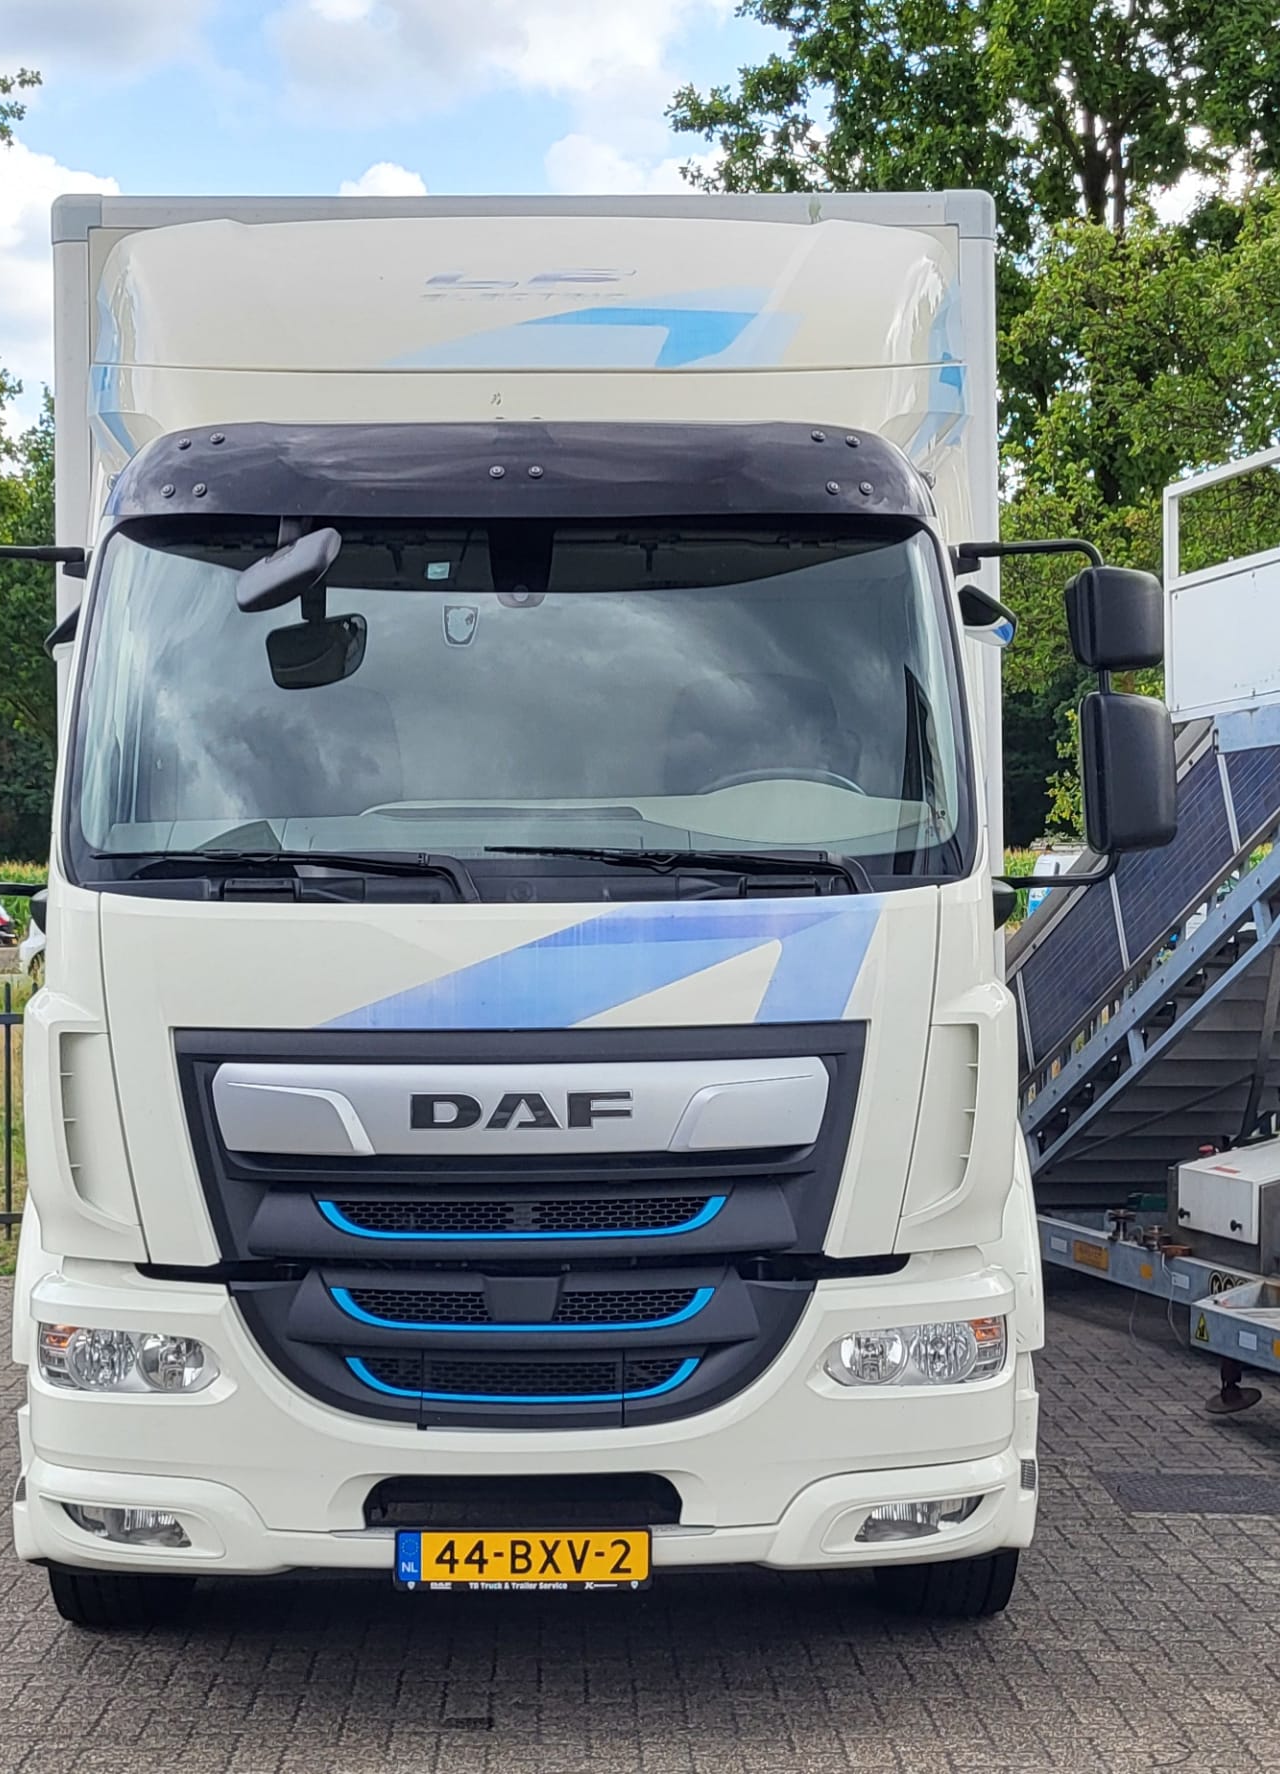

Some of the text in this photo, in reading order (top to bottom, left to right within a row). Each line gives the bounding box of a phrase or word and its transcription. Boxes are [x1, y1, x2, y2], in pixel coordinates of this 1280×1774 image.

[408, 1089, 634, 1131] DAF
[401, 1539, 632, 1574] NL 44-BXV-2
[480, 1582, 502, 1590] Truck
[503, 1582, 510, 1590] &
[511, 1582, 538, 1590] Trailer
[538, 1582, 568, 1590] Service
